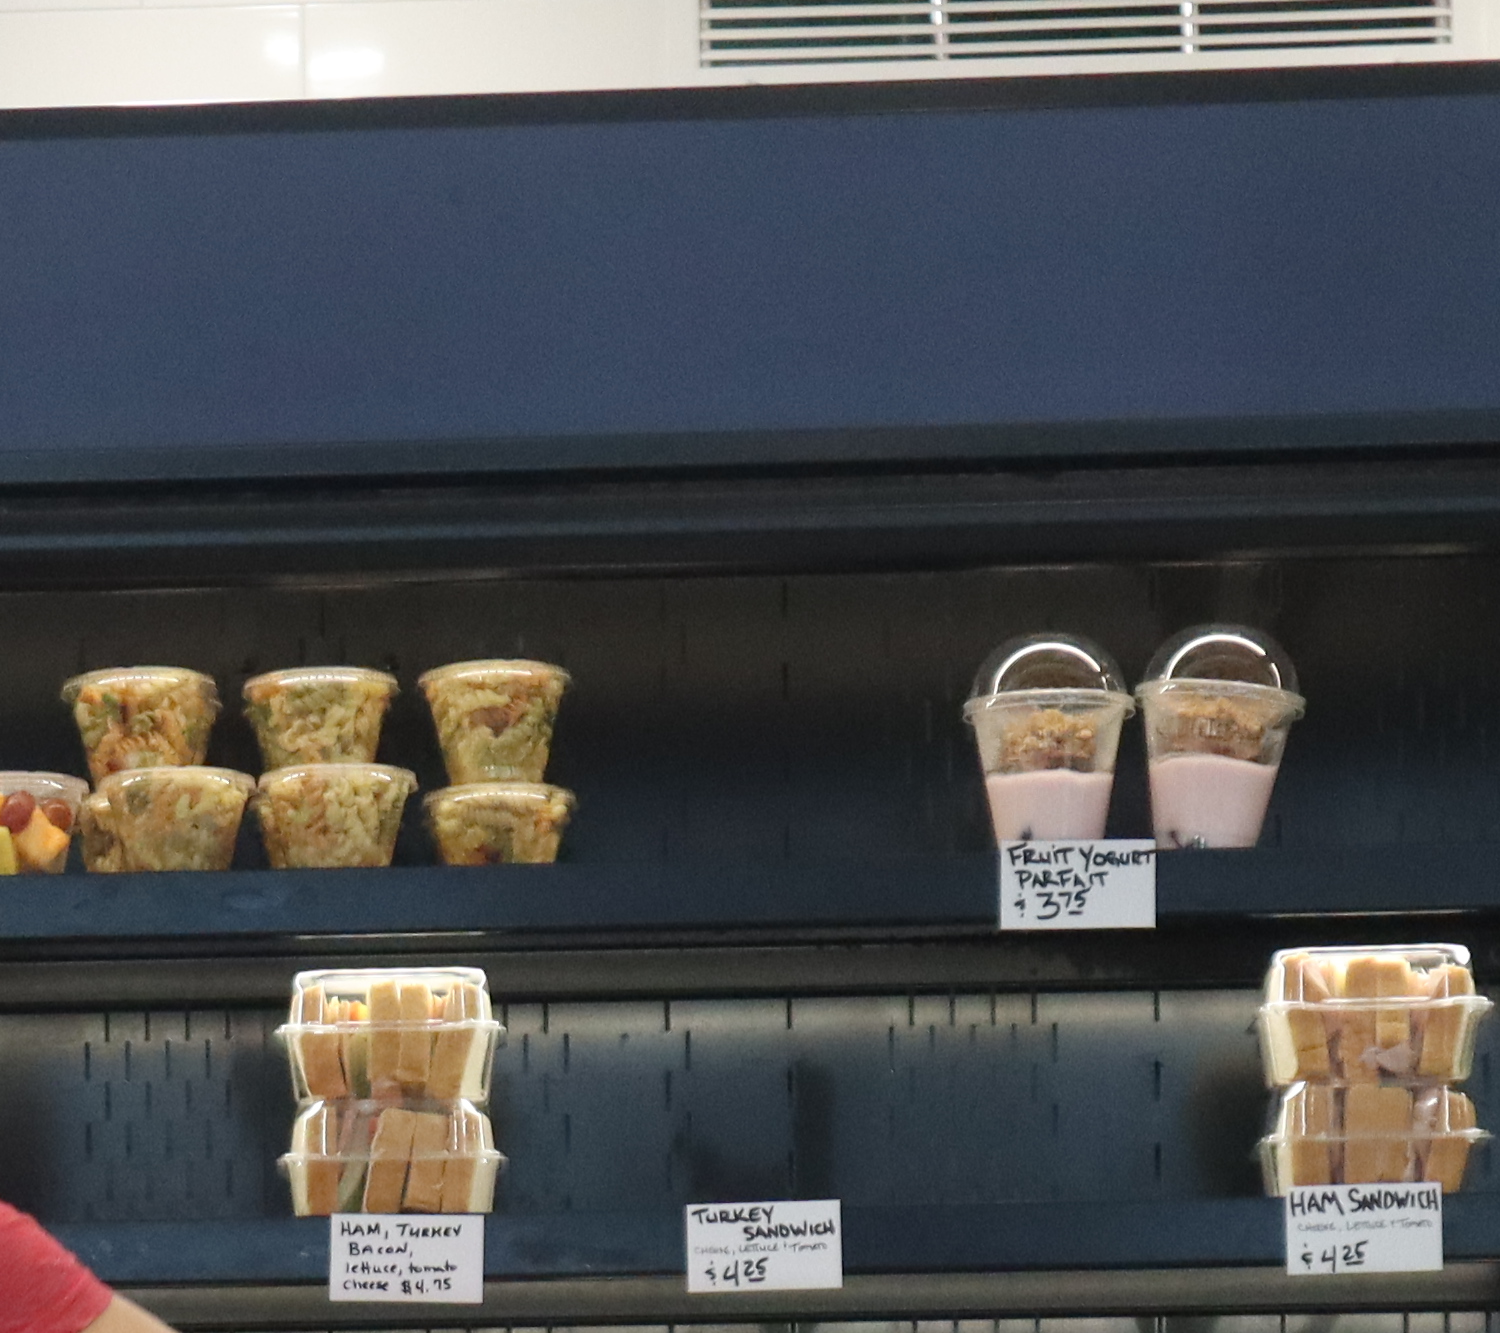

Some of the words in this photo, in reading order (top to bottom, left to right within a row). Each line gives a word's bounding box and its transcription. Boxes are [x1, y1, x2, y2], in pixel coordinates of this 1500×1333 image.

[1006, 842, 1075, 866] FRUIT
[1080, 845, 1156, 872] YOGURT
[1015, 869, 1108, 889] PARFAIT
[1289, 1190, 1345, 1217] HAM
[1349, 1187, 1440, 1213] SANDWICH
[692, 1205, 774, 1225] TURKEY
[340, 1222, 389, 1240] HAM,
[396, 1223, 463, 1239] TURKEY
[743, 1219, 835, 1241] SANDWICH
[408, 1259, 459, 1274] tomato
